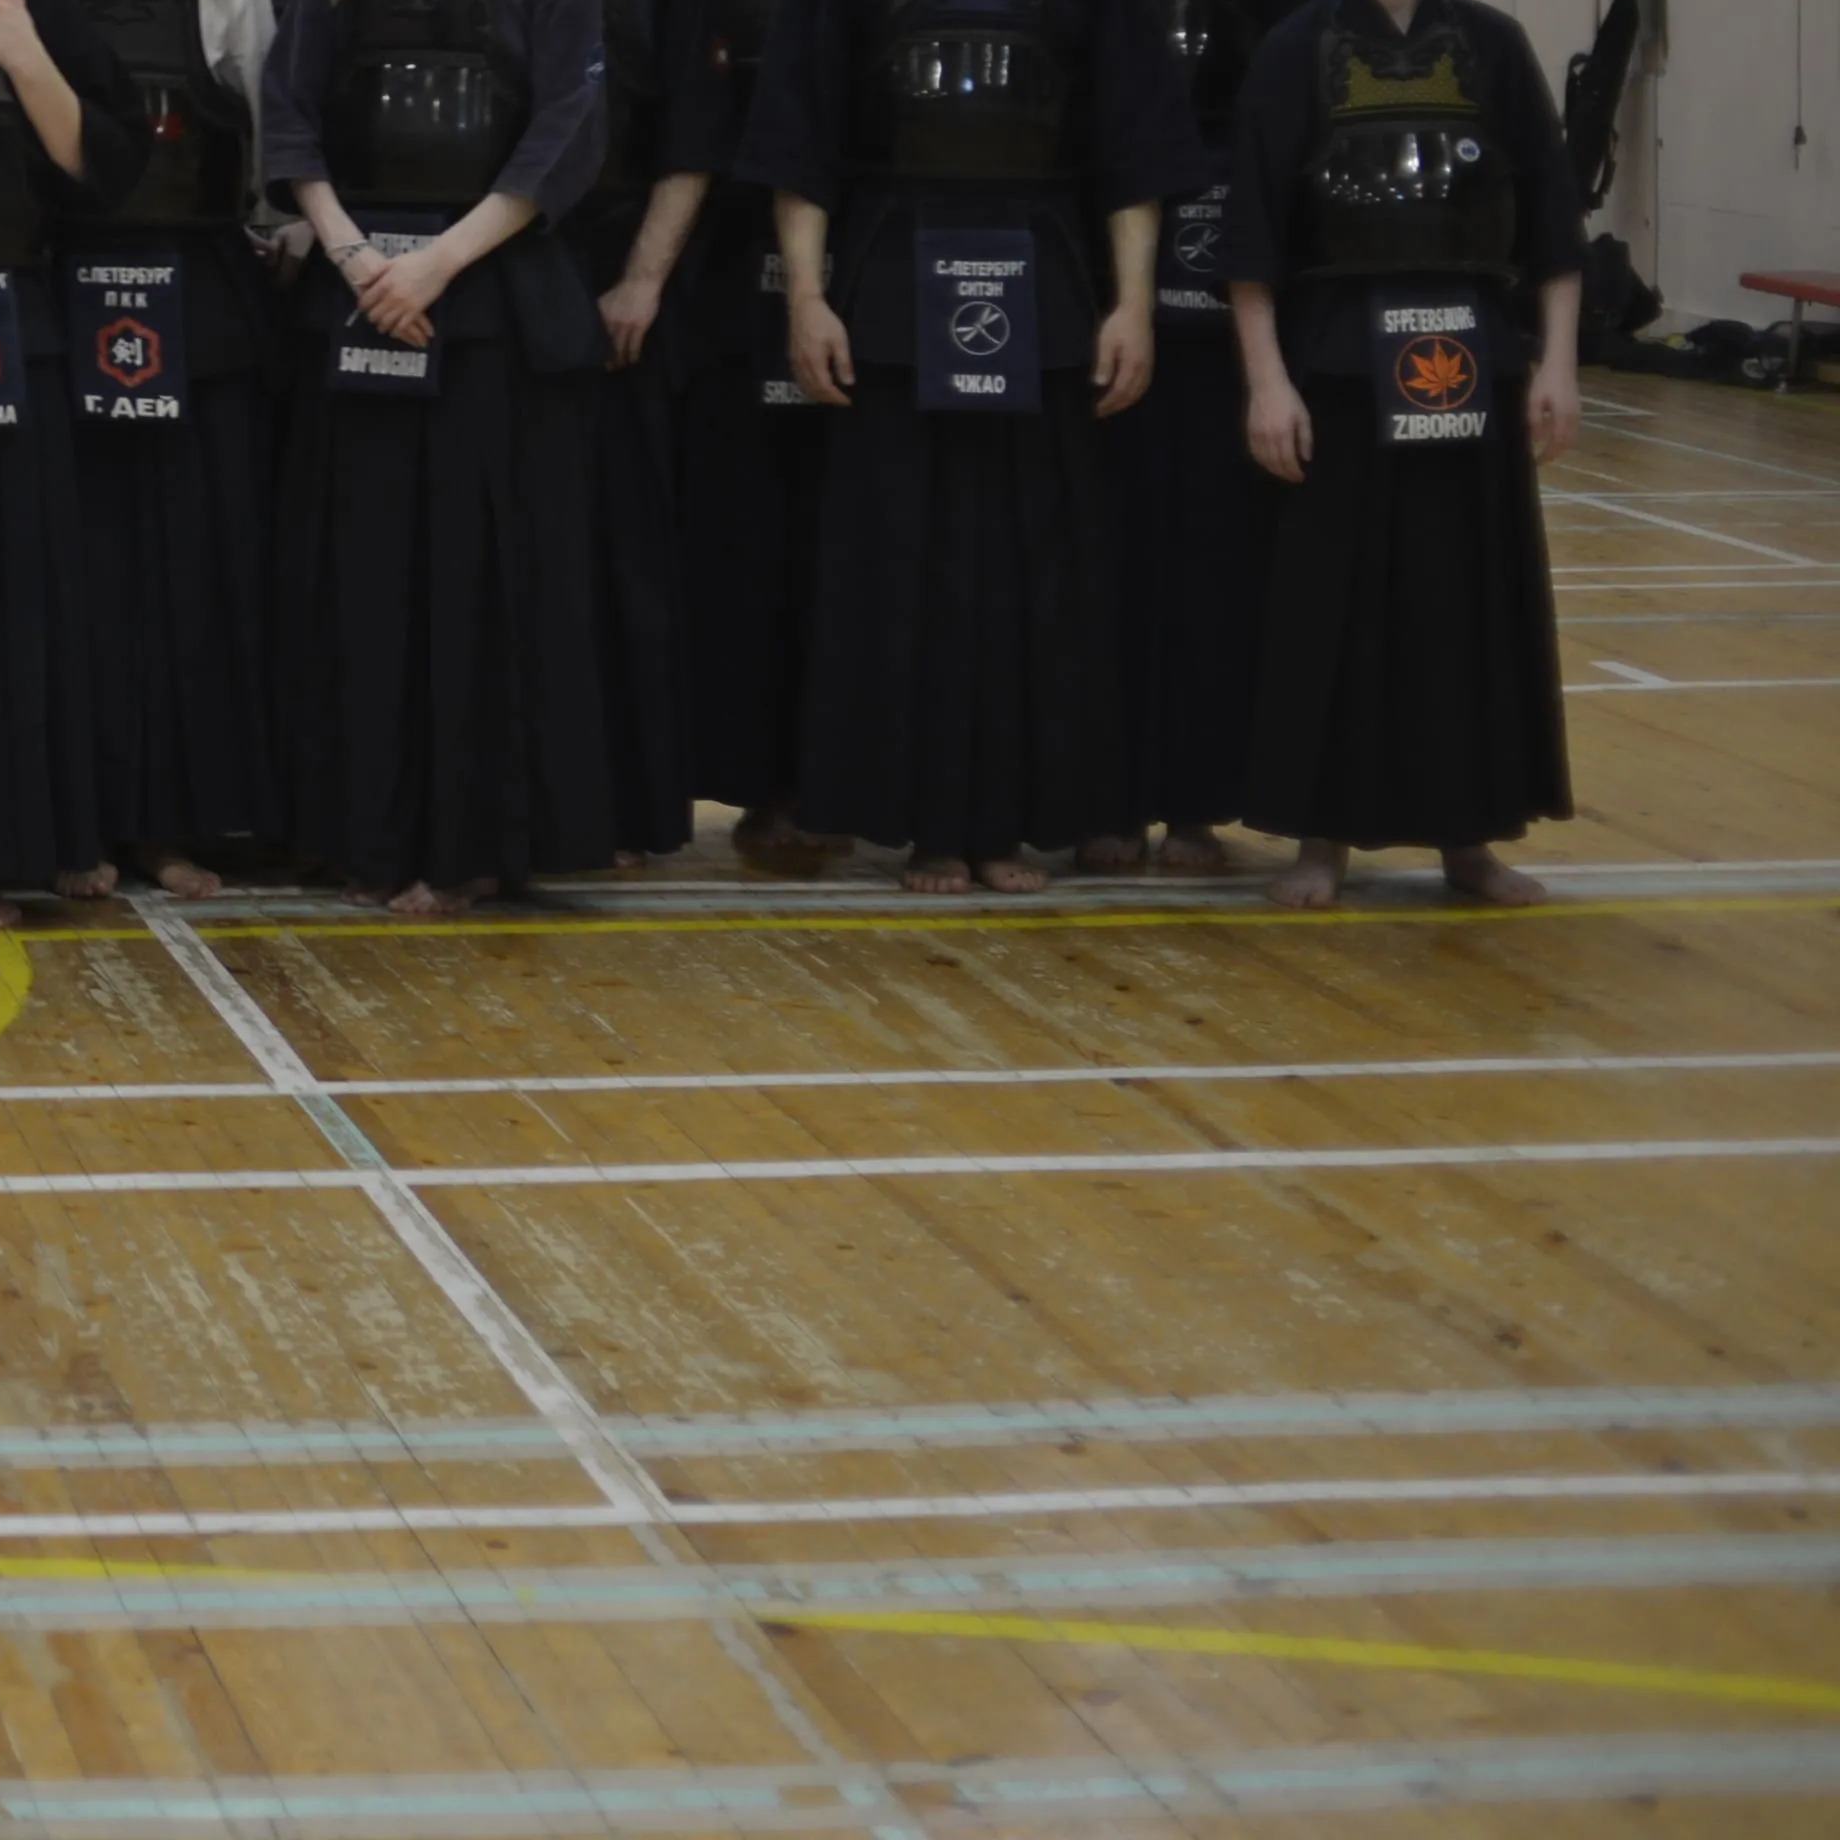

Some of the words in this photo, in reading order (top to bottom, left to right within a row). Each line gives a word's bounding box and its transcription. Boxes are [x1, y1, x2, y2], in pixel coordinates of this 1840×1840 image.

[76, 266, 175, 286] С.ПЕТЕРБУРГ
[952, 373, 1007, 395] ЧЖАО
[1391, 410, 1488, 441] ZIBOROV
